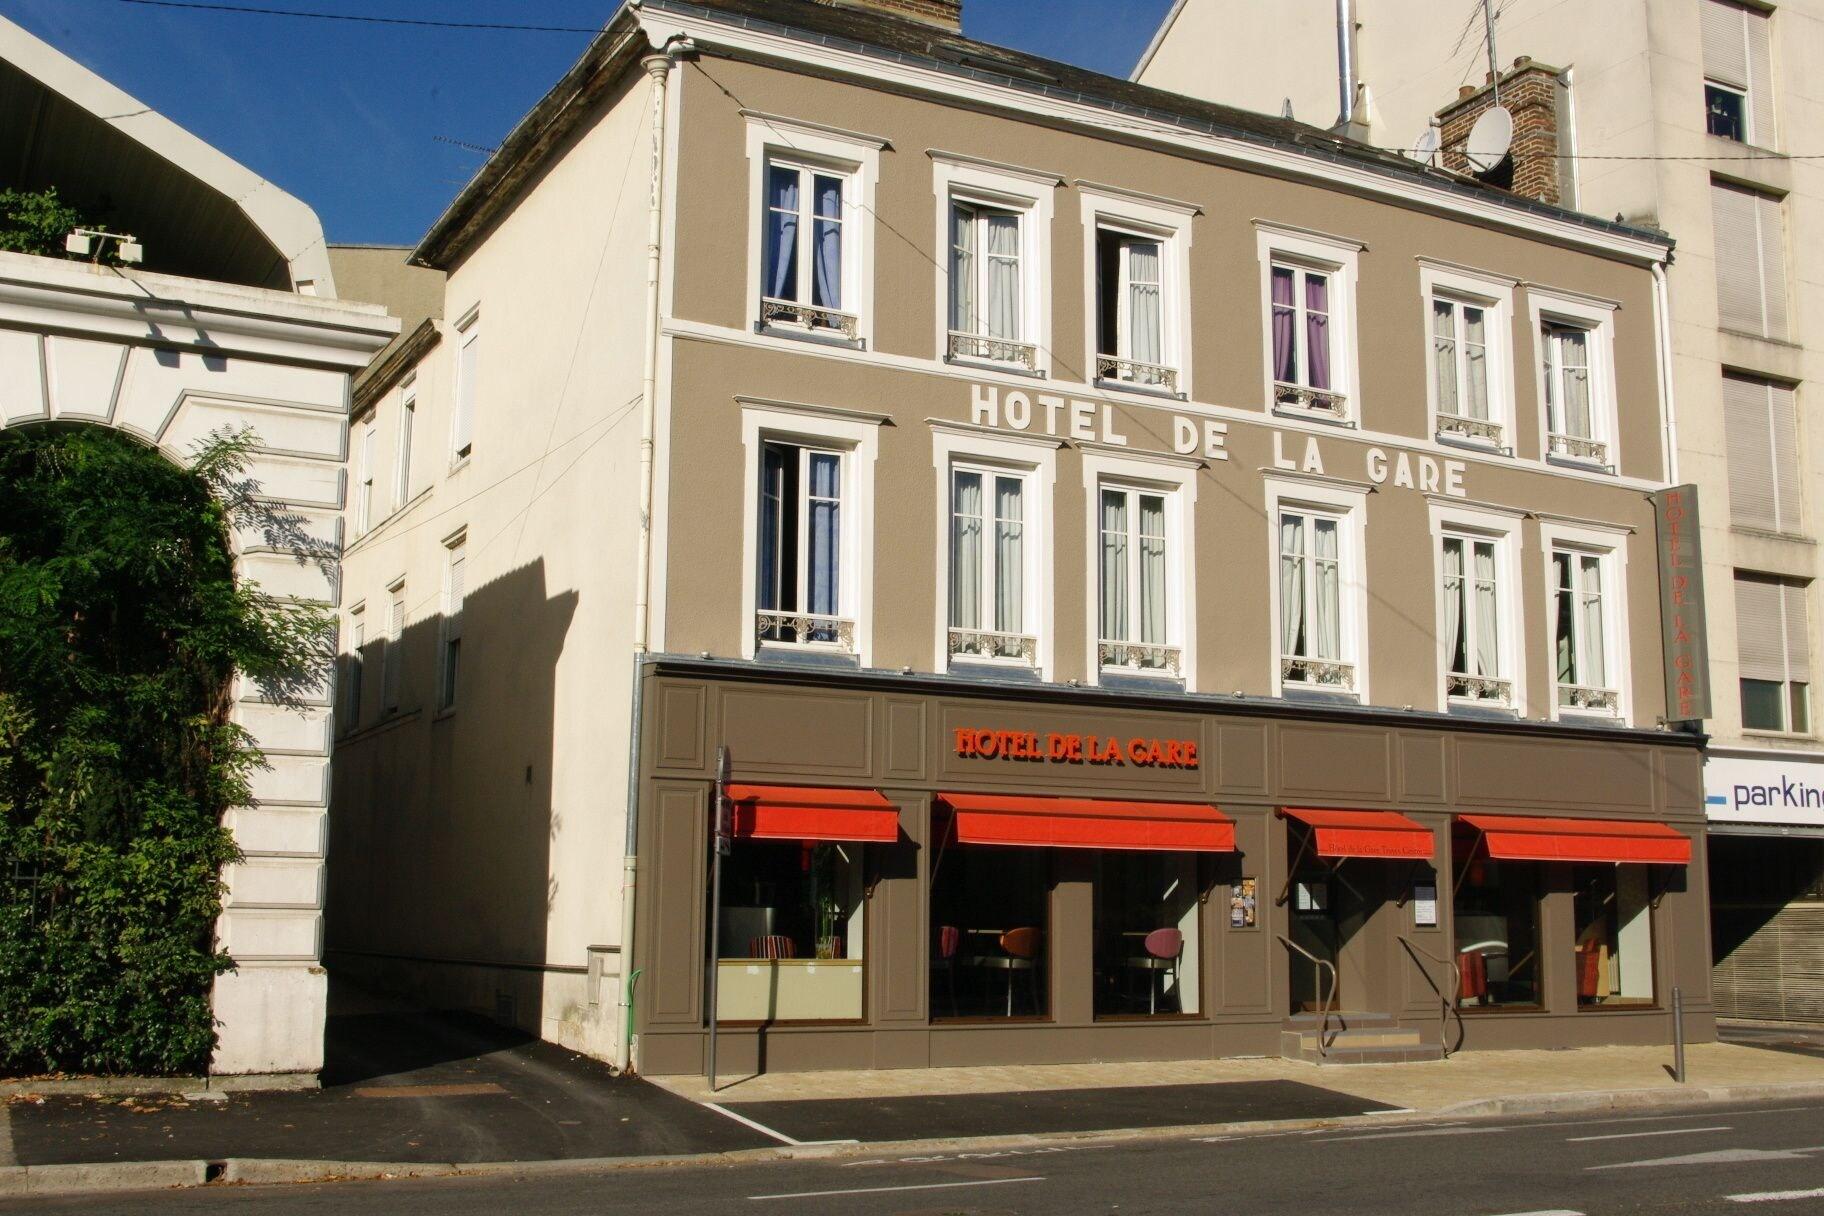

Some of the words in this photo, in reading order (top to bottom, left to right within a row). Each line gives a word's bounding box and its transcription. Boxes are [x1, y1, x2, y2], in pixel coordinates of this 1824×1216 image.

[971, 384, 1127, 446] HOTEL
[1174, 416, 1228, 460] DE
[1274, 432, 1324, 475] LA
[1366, 448, 1466, 495] GARE
[1665, 492, 1685, 568] HOTEL
[1672, 576, 1689, 606] DE
[1674, 614, 1690, 644] LA
[1674, 653, 1695, 717] GARE
[953, 728, 1041, 757] HOTEL
[1047, 733, 1081, 759] DE
[1088, 735, 1124, 761] LA
[1128, 738, 1198, 766] GARE
[1733, 774, 1824, 811] parkin
